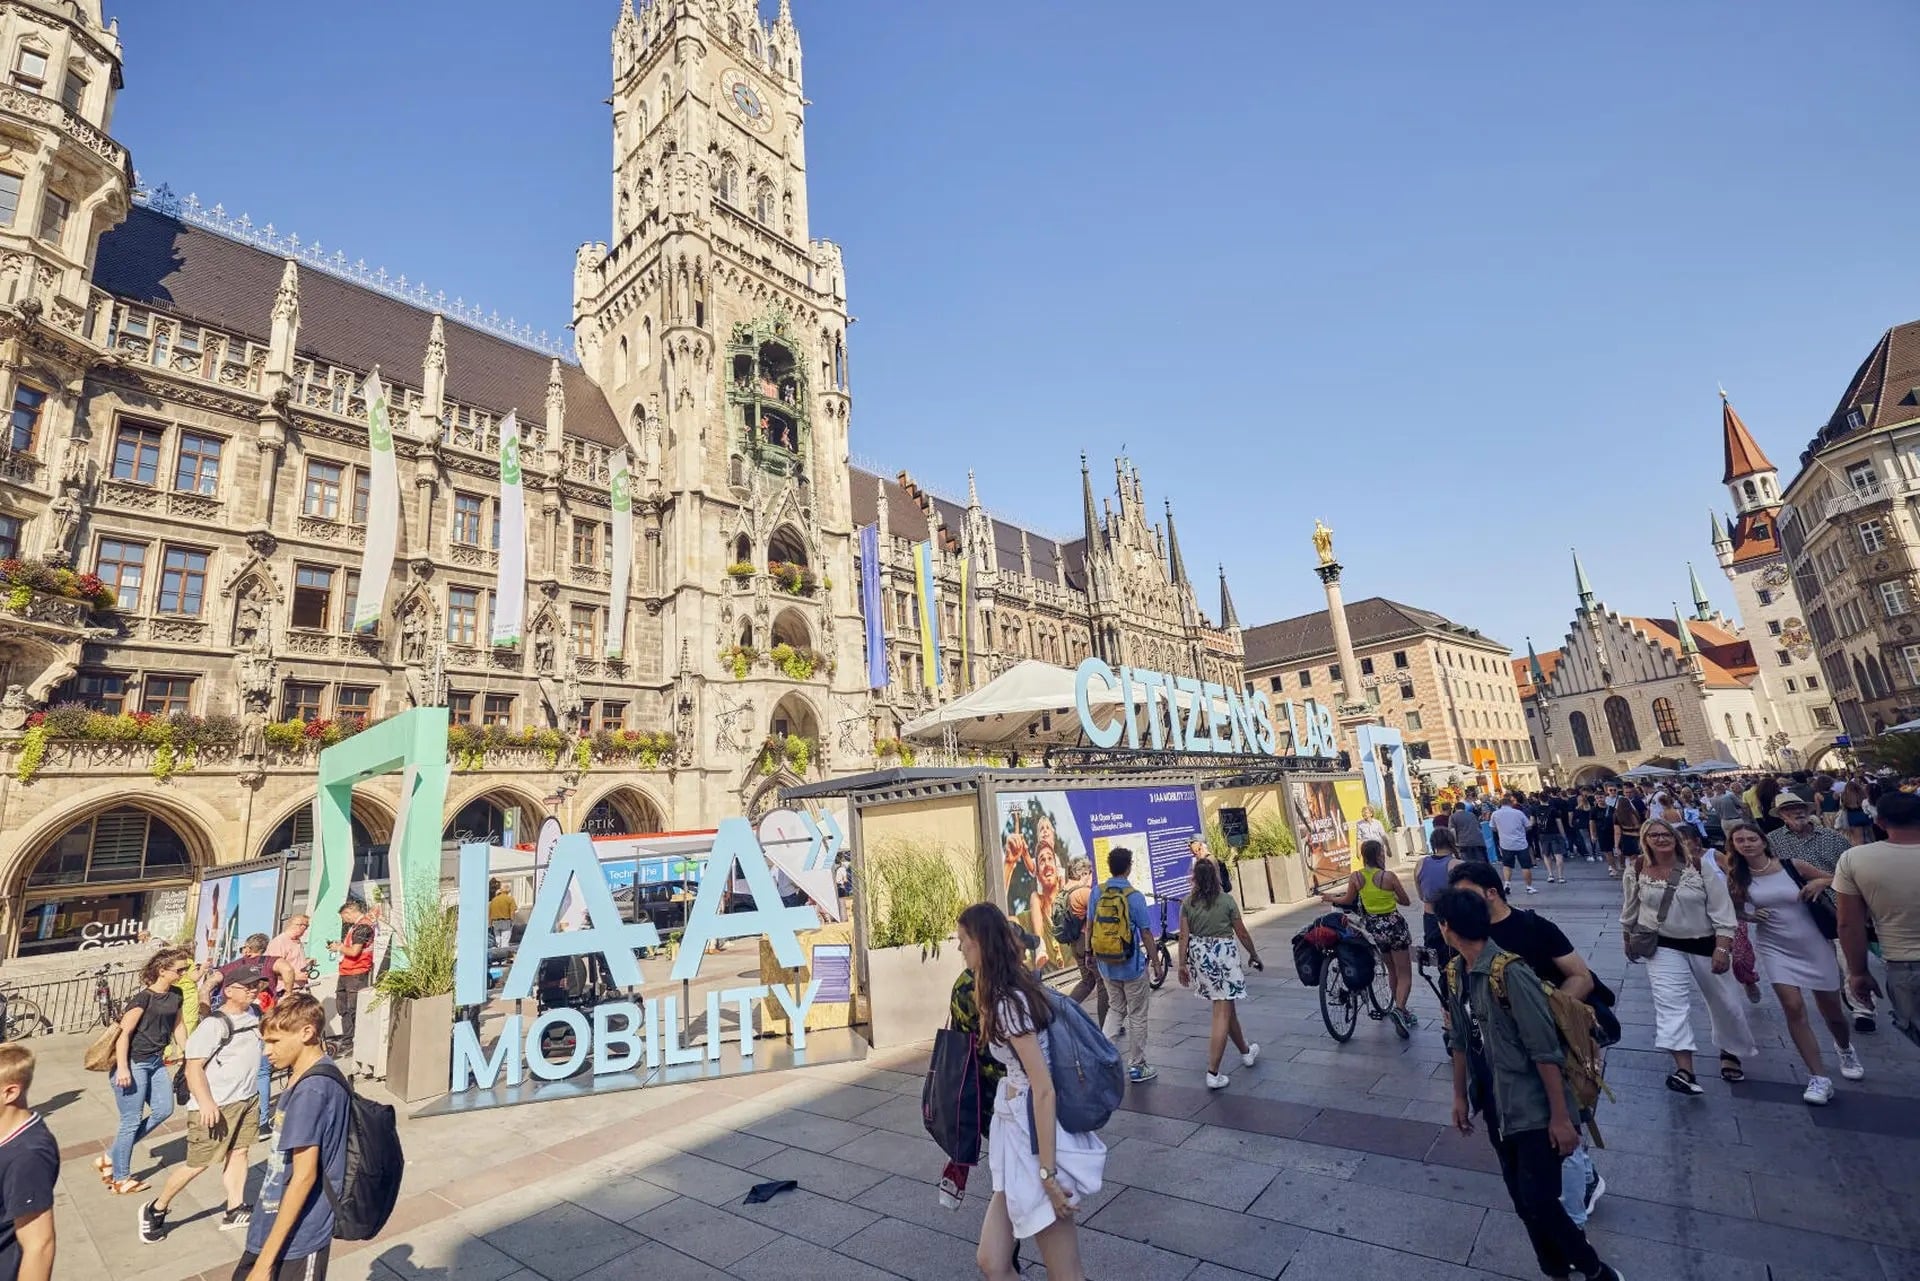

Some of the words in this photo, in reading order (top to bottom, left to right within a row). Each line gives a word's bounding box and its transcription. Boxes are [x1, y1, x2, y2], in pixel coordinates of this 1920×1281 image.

[1383, 670, 1413, 684] BECK
[1075, 657, 1275, 756] CITIZENS
[1284, 699, 1337, 758] LAB
[504, 809, 513, 828] S
[579, 818, 615, 830] OPTIK
[454, 816, 821, 1006] IAA
[452, 978, 822, 1093] MOBILITY
